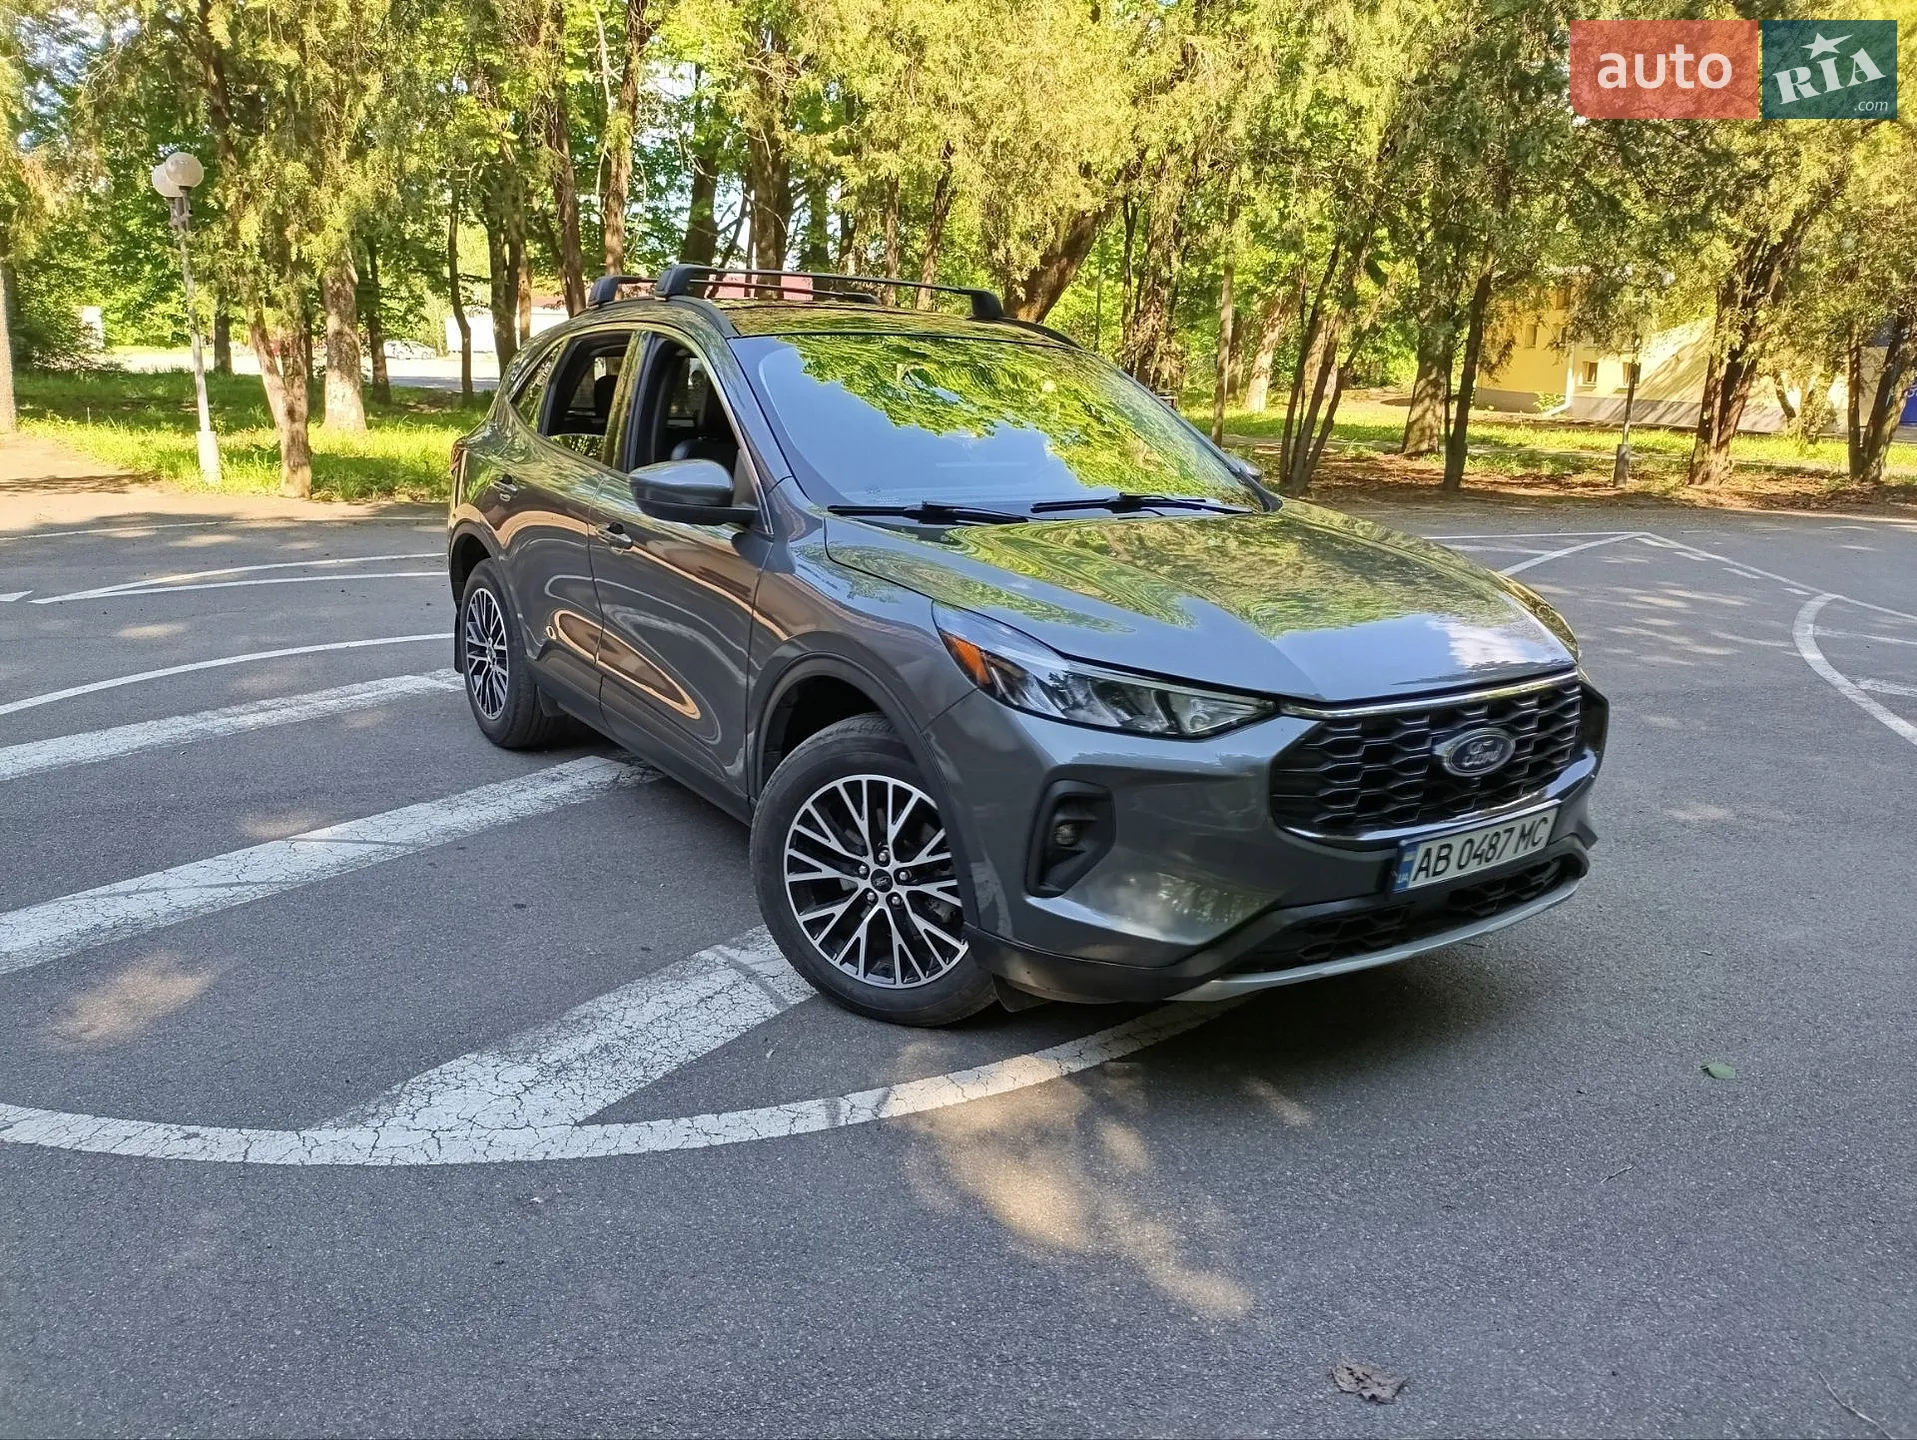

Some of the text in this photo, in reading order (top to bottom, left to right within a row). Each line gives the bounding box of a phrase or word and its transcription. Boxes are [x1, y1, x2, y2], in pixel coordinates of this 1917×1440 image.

[1411, 816, 1548, 881] AB 0487 MC
